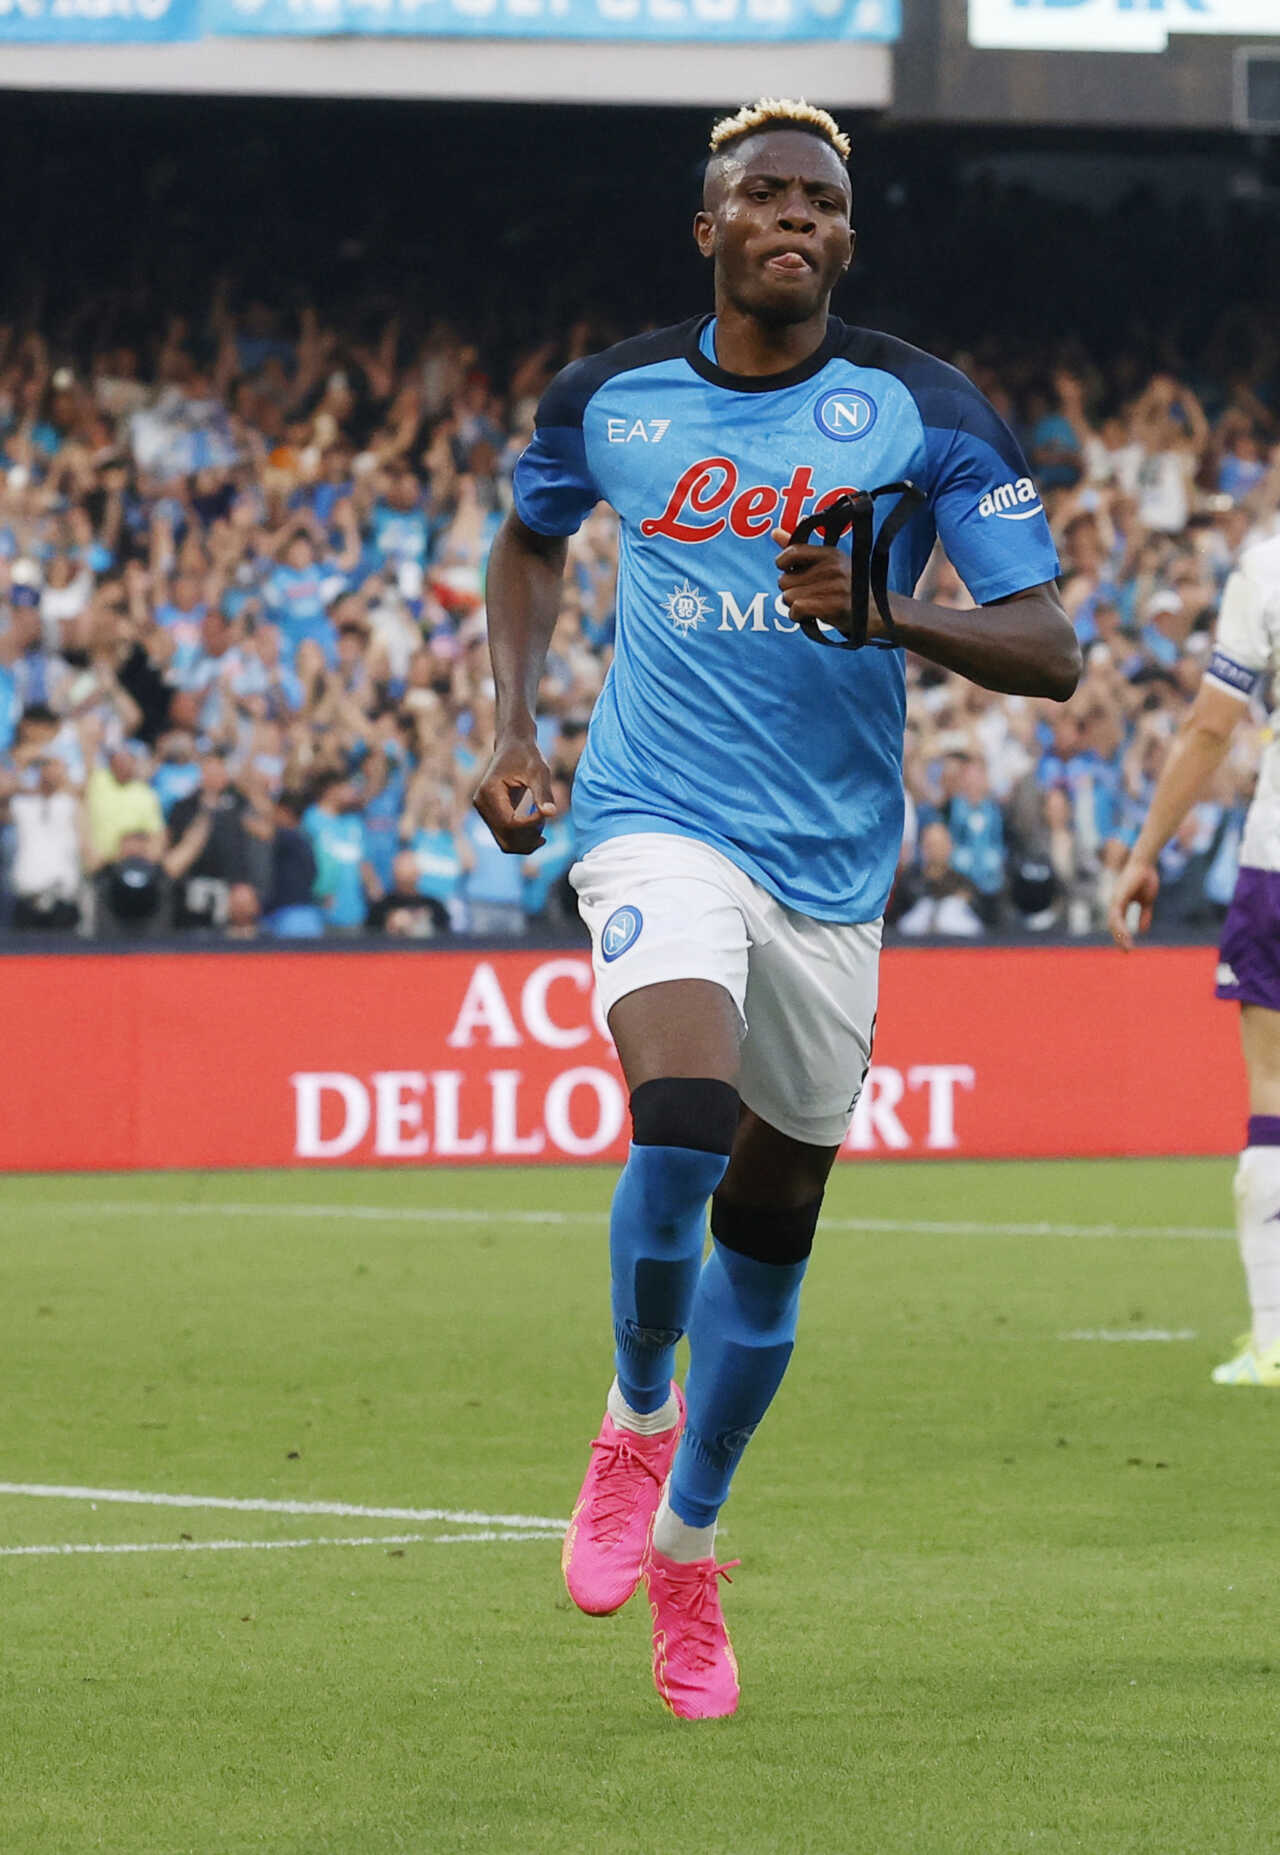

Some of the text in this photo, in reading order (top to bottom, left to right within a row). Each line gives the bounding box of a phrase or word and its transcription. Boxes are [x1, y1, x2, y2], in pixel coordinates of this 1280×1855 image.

[607, 418, 672, 443] EA7
[716, 591, 835, 633] MS
[446, 958, 614, 1058] AC
[289, 1066, 626, 1157] DELLO
